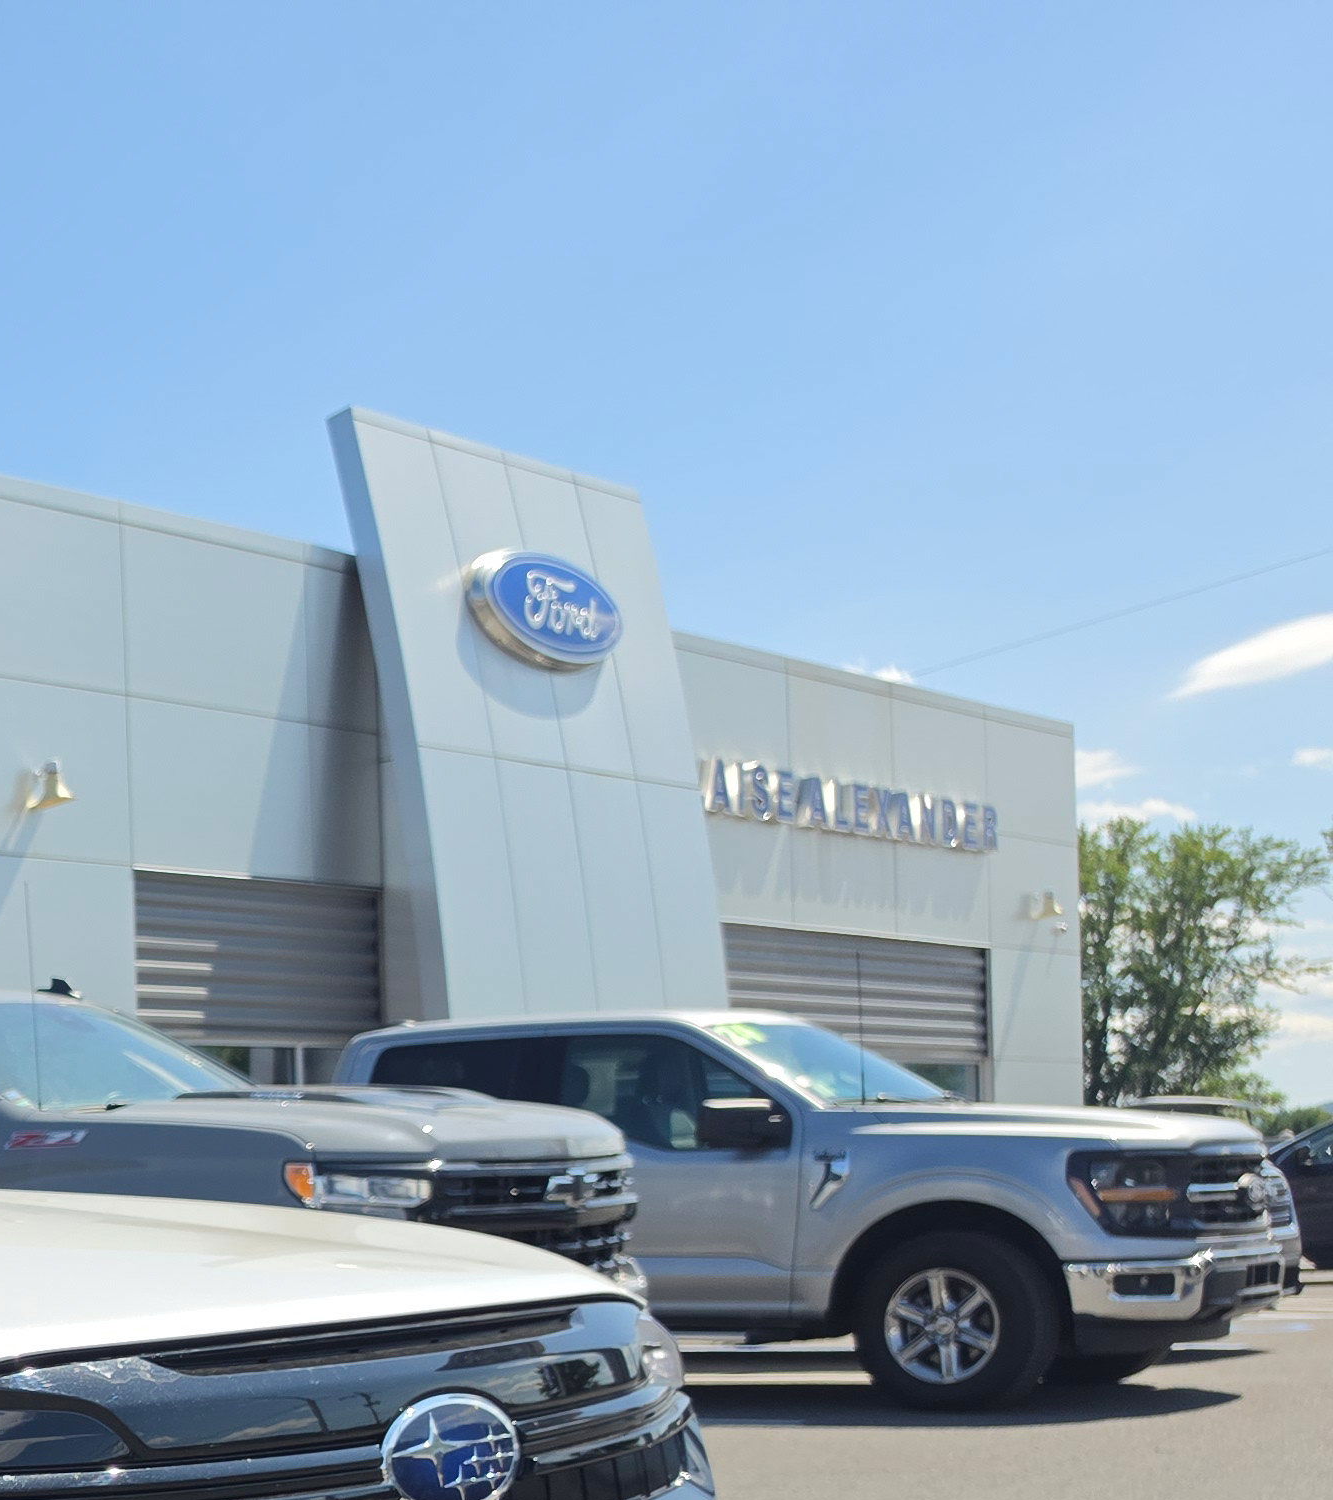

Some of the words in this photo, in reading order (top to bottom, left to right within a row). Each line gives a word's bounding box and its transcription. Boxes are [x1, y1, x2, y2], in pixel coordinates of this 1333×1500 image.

[523, 568, 602, 641] Ford
[700, 756, 794, 824] AISE
[795, 776, 999, 853] ALEXANDER
